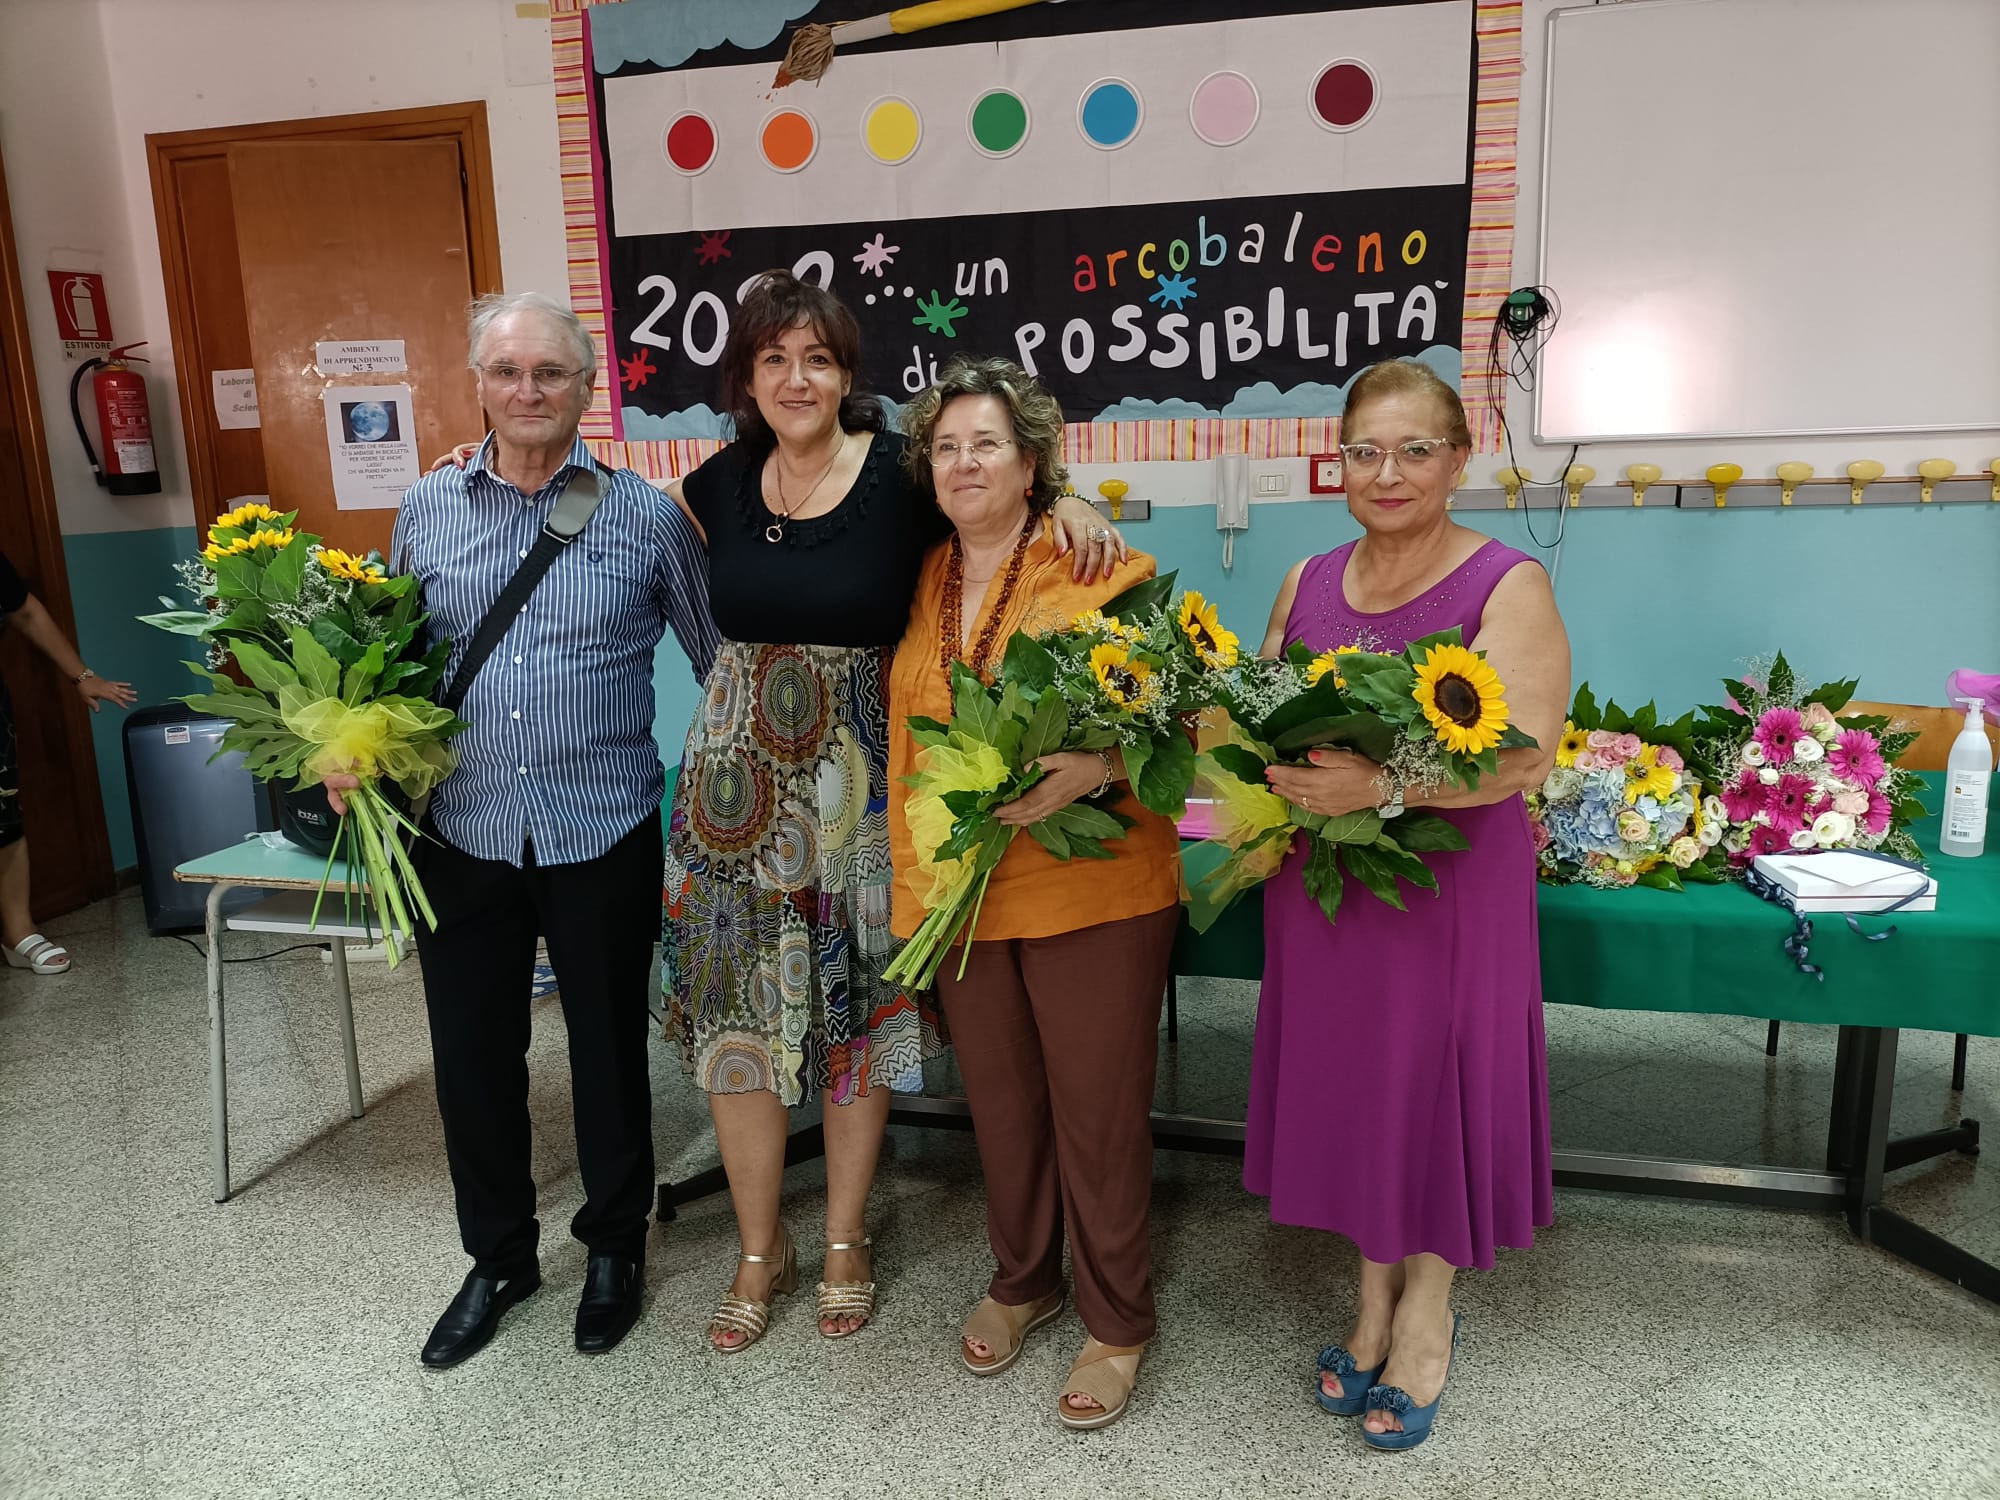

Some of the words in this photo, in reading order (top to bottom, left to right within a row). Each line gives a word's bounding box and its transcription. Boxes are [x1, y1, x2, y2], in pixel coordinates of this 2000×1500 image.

[630, 250, 834, 367] 20
[955, 256, 1009, 296] un
[1073, 211, 1427, 292] arcobaleno
[65, 341, 111, 350] ESTINTORE
[341, 345, 381, 353] AMBIENTE
[334, 356, 400, 364] APPRENDIMENTO
[366, 363, 374, 371] 3
[902, 345, 942, 393] di
